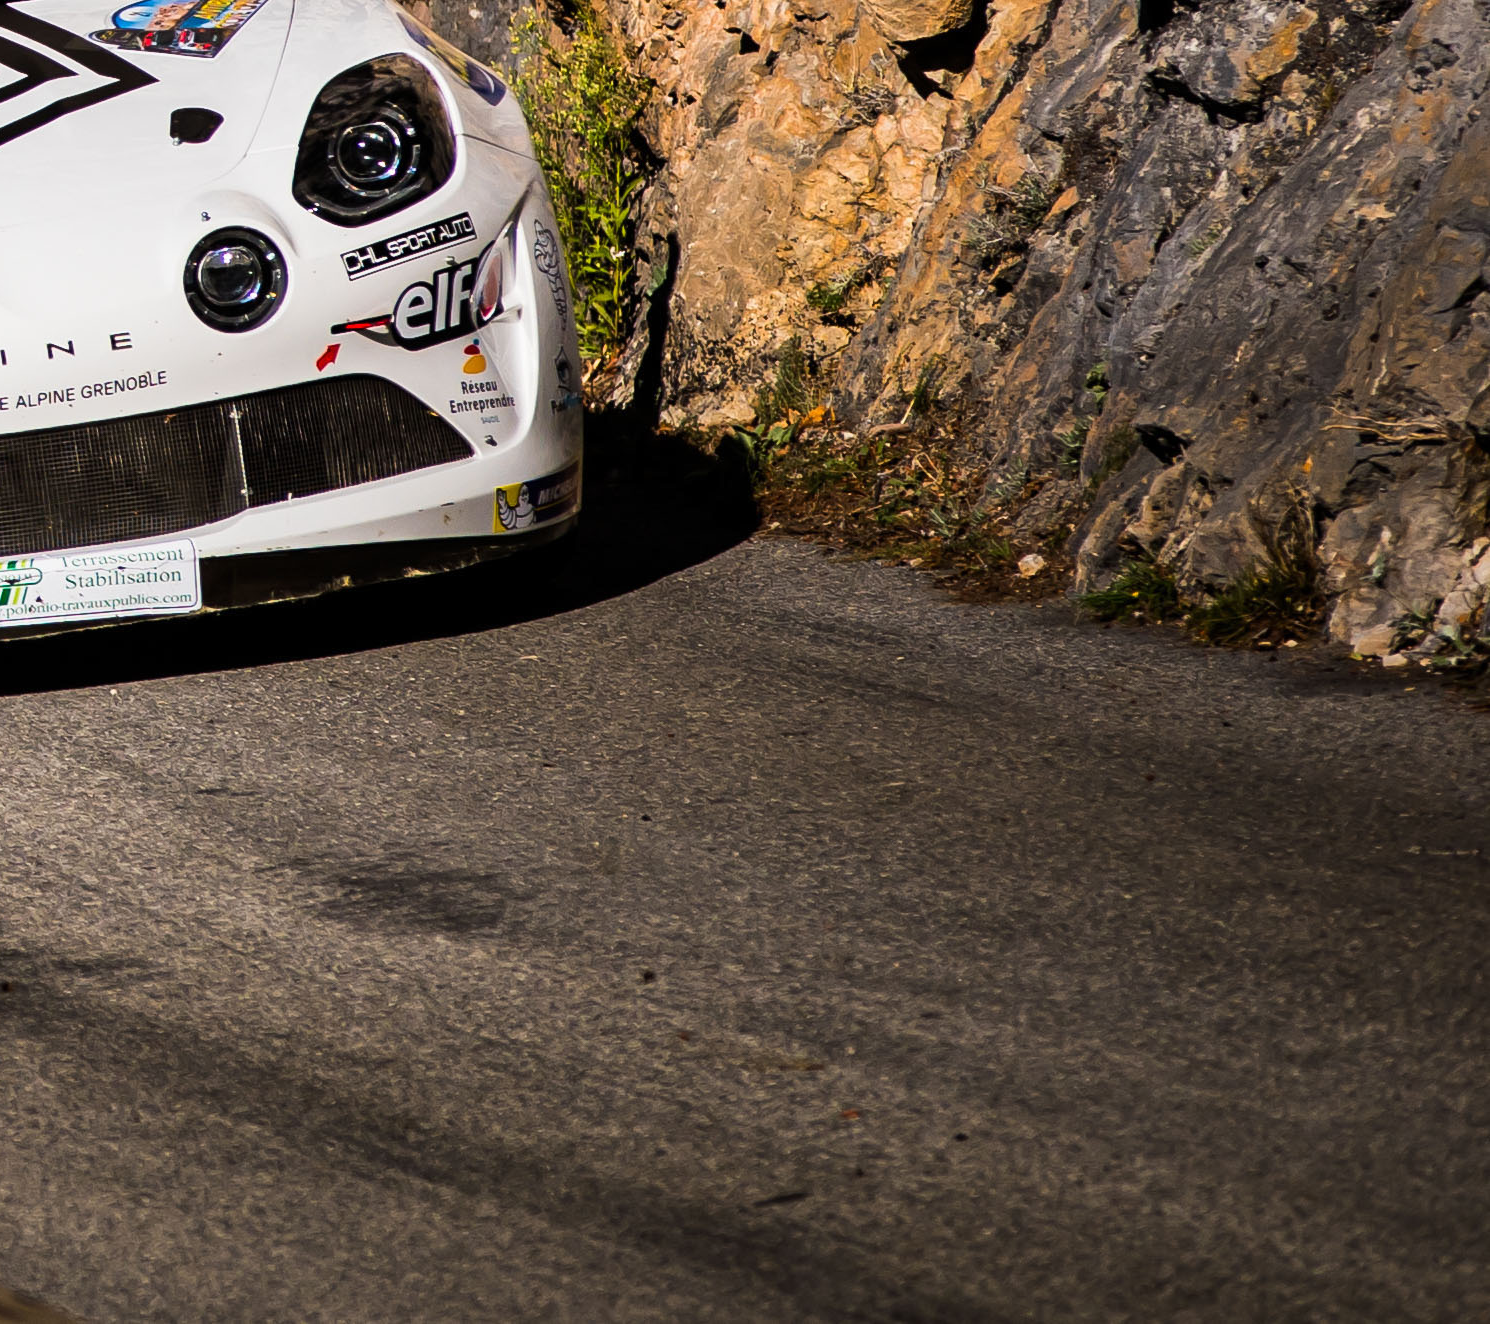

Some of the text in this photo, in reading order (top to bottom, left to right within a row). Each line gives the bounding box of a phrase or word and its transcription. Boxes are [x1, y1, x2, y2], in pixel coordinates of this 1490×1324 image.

[341, 215, 474, 273] CHL SPORT AUTO
[395, 264, 473, 340] elf
[15, 387, 76, 409] ALPINE
[80, 370, 168, 399] GRENOBLE
[460, 380, 498, 395] Réseau
[449, 393, 516, 414] Entreprendre
[65, 569, 183, 590] Stabilisation
